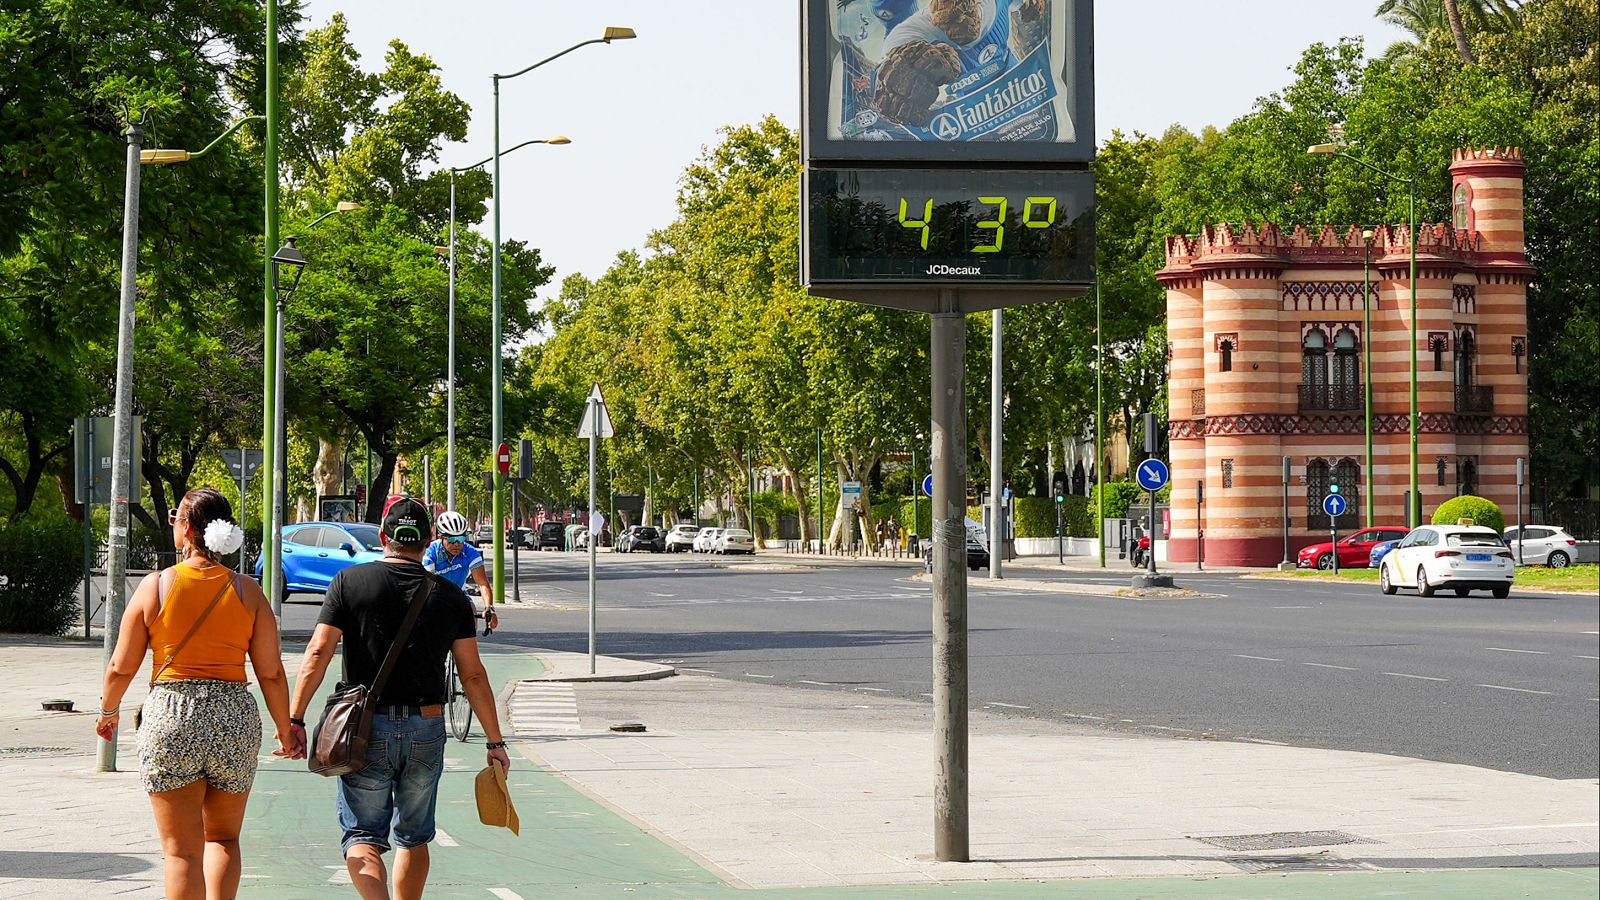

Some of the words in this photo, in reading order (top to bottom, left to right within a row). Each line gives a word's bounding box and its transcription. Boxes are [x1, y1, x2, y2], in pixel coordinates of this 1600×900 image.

[955, 68, 1047, 133] Fantásticos
[973, 109, 1017, 134] PRIMEROS
[1020, 92, 1047, 110] PASOS
[1016, 125, 1026, 135] 24
[1025, 121, 1035, 130] DE
[1034, 114, 1052, 127] JULIO
[925, 264, 981, 276] JCDecaux
